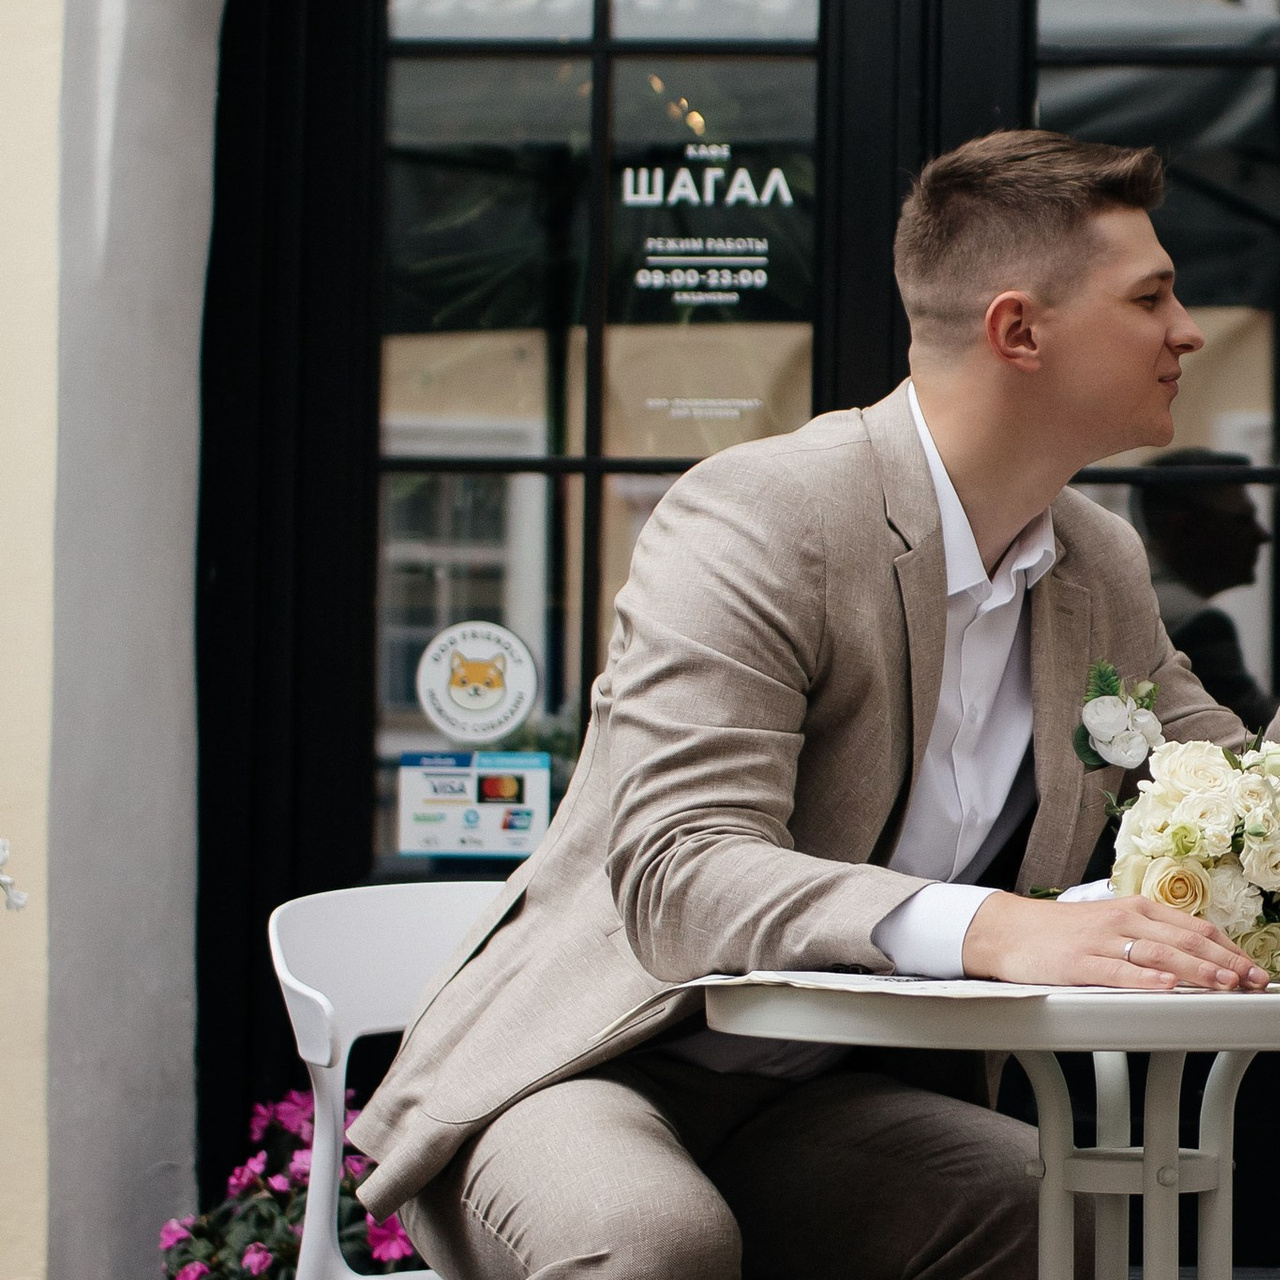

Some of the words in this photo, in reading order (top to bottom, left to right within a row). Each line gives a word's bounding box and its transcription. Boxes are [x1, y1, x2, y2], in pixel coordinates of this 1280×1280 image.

[686, 144, 731, 158] КАФЕ
[622, 167, 794, 206] ШАГАЛ
[646, 237, 702, 252] РЕЖИМ
[705, 237, 768, 252] РАБОТЫ
[635, 269, 768, 288] 09:00-23:00
[431, 637, 457, 663] DOG
[461, 629, 524, 665] FRIENDLY
[431, 780, 468, 795] VISA
